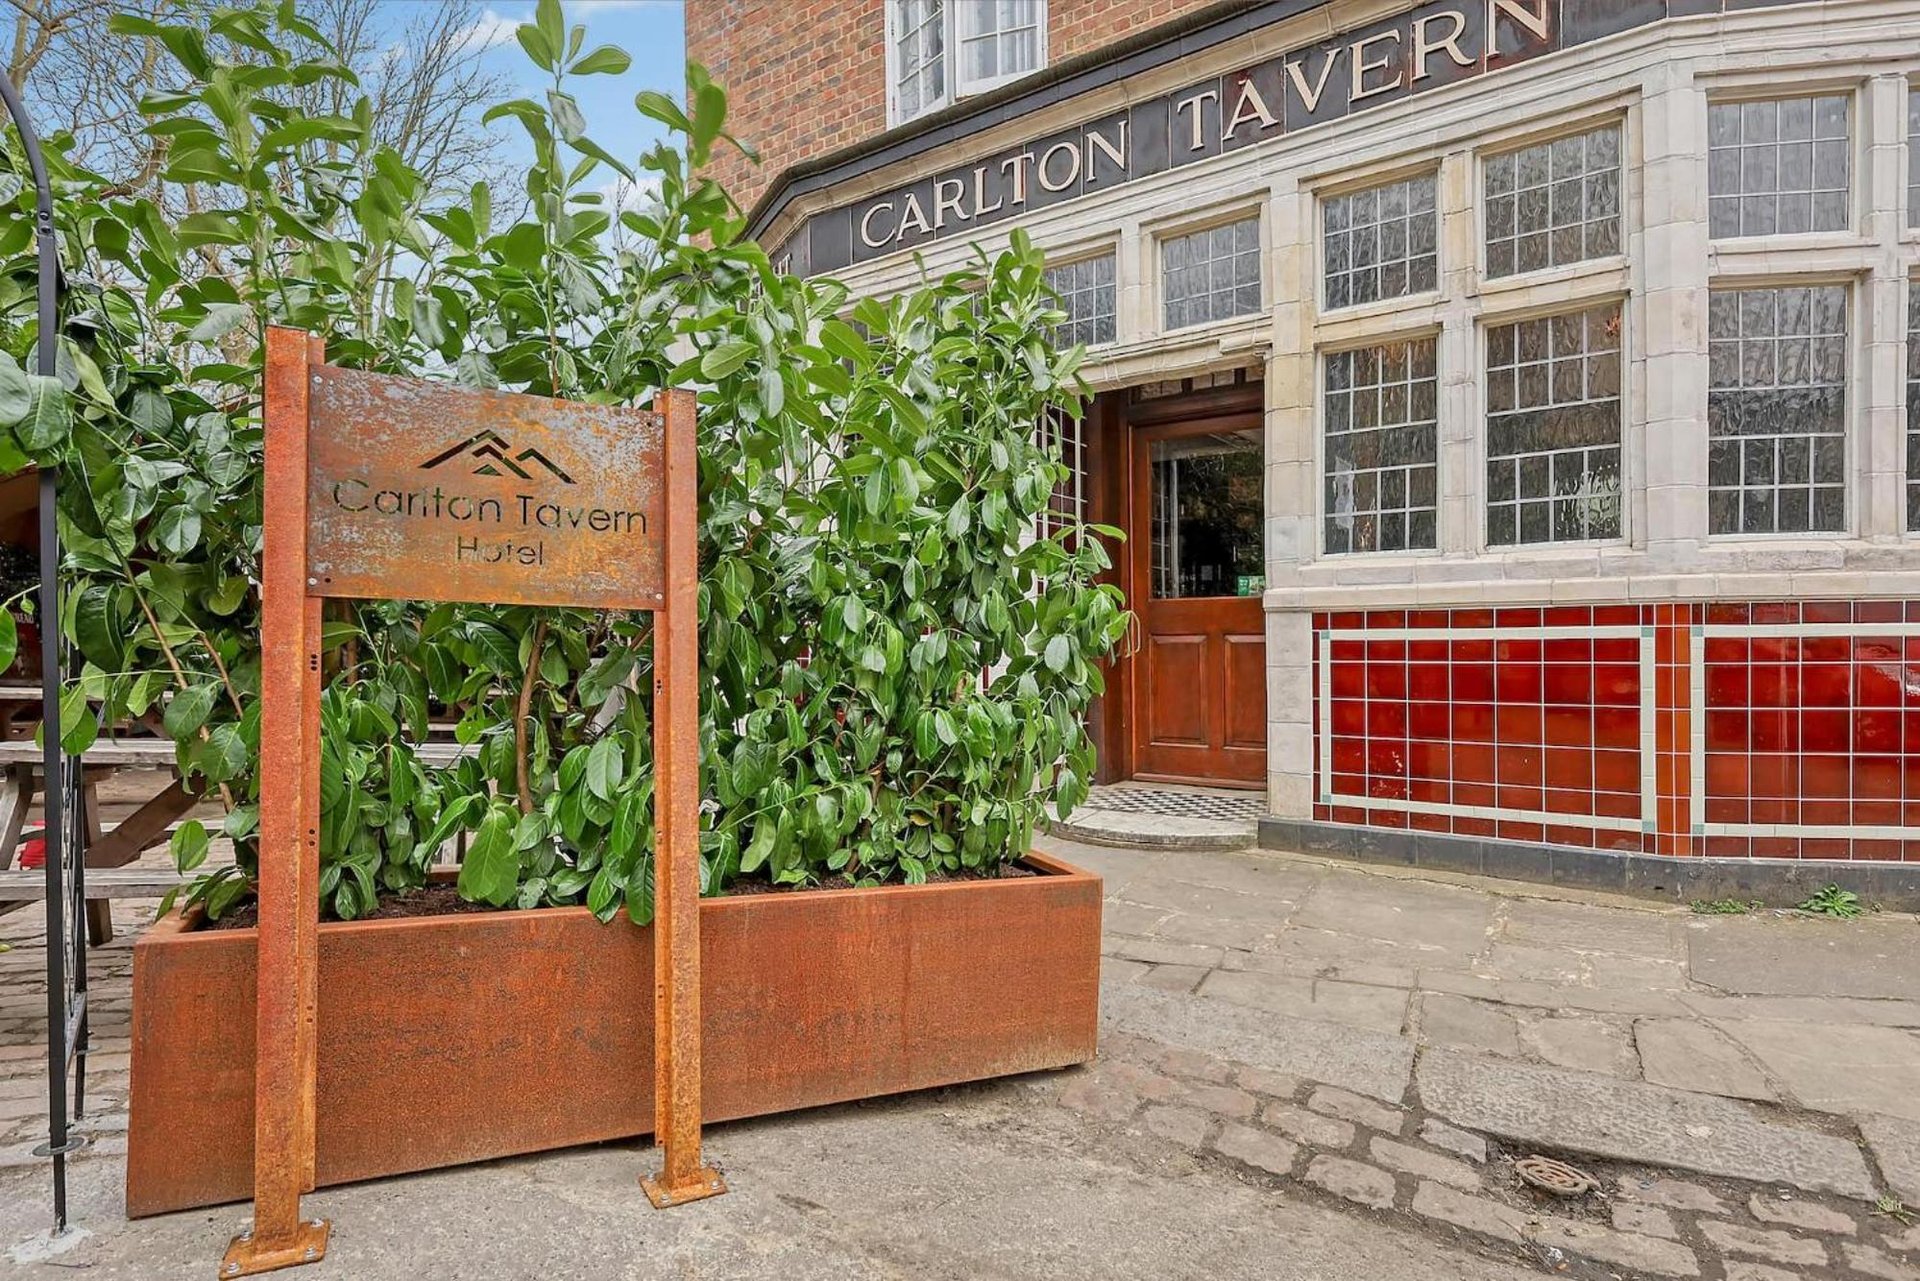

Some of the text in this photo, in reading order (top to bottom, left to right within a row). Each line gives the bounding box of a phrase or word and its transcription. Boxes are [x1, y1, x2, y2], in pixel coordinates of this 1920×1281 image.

[860, 0, 1548, 248] CARLTON TAVERN
[333, 478, 647, 534] Carlton Tavern
[457, 536, 543, 565] Hotel
